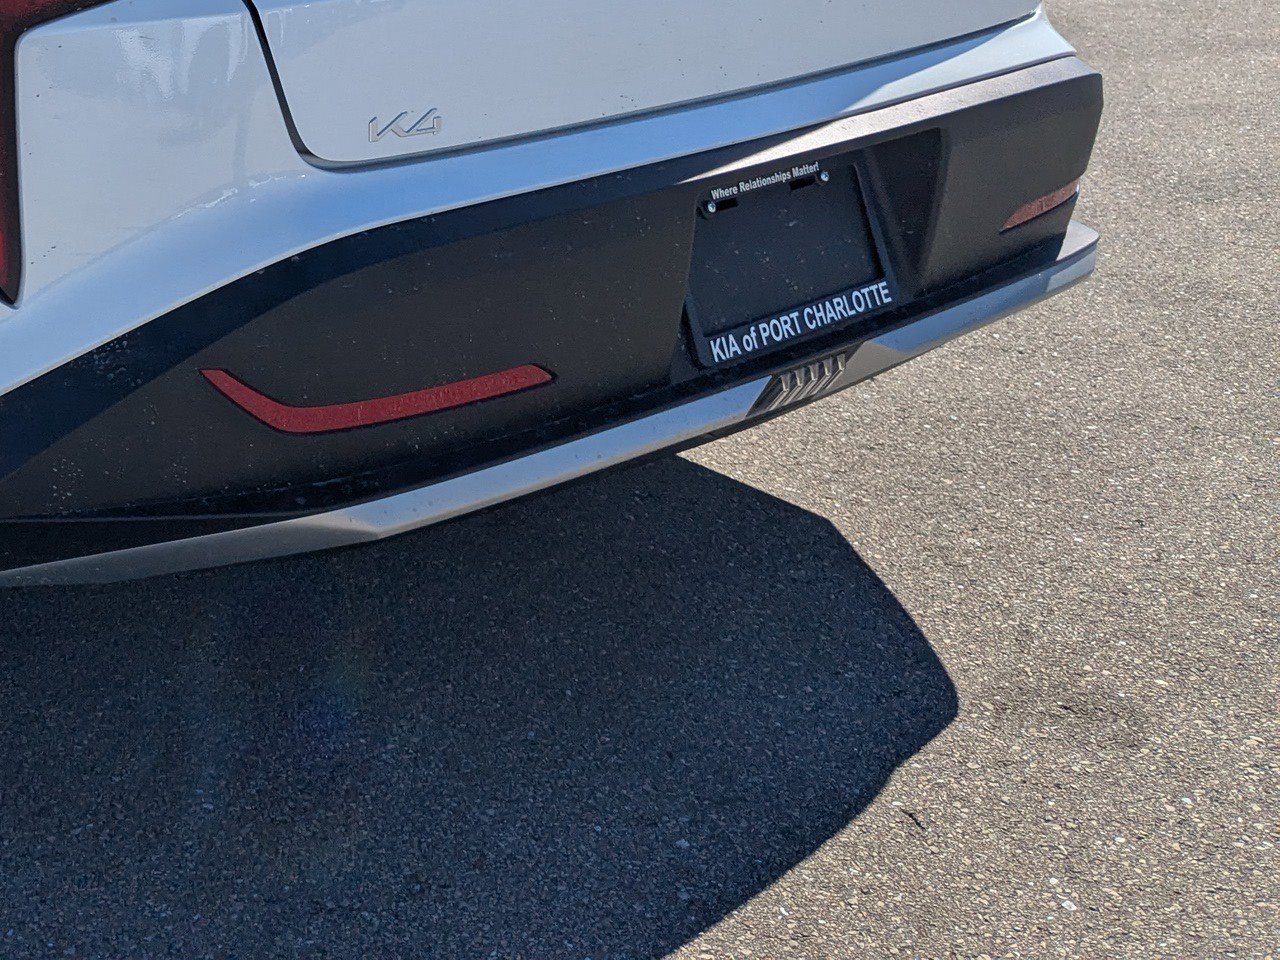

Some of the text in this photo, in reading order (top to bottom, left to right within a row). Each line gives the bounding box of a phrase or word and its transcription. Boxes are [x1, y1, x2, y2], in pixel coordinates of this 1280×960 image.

[368, 107, 441, 143] K4
[711, 161, 820, 201] Where Relationships Matter!
[710, 281, 892, 363] KIA of PORT CHARLOTTE
